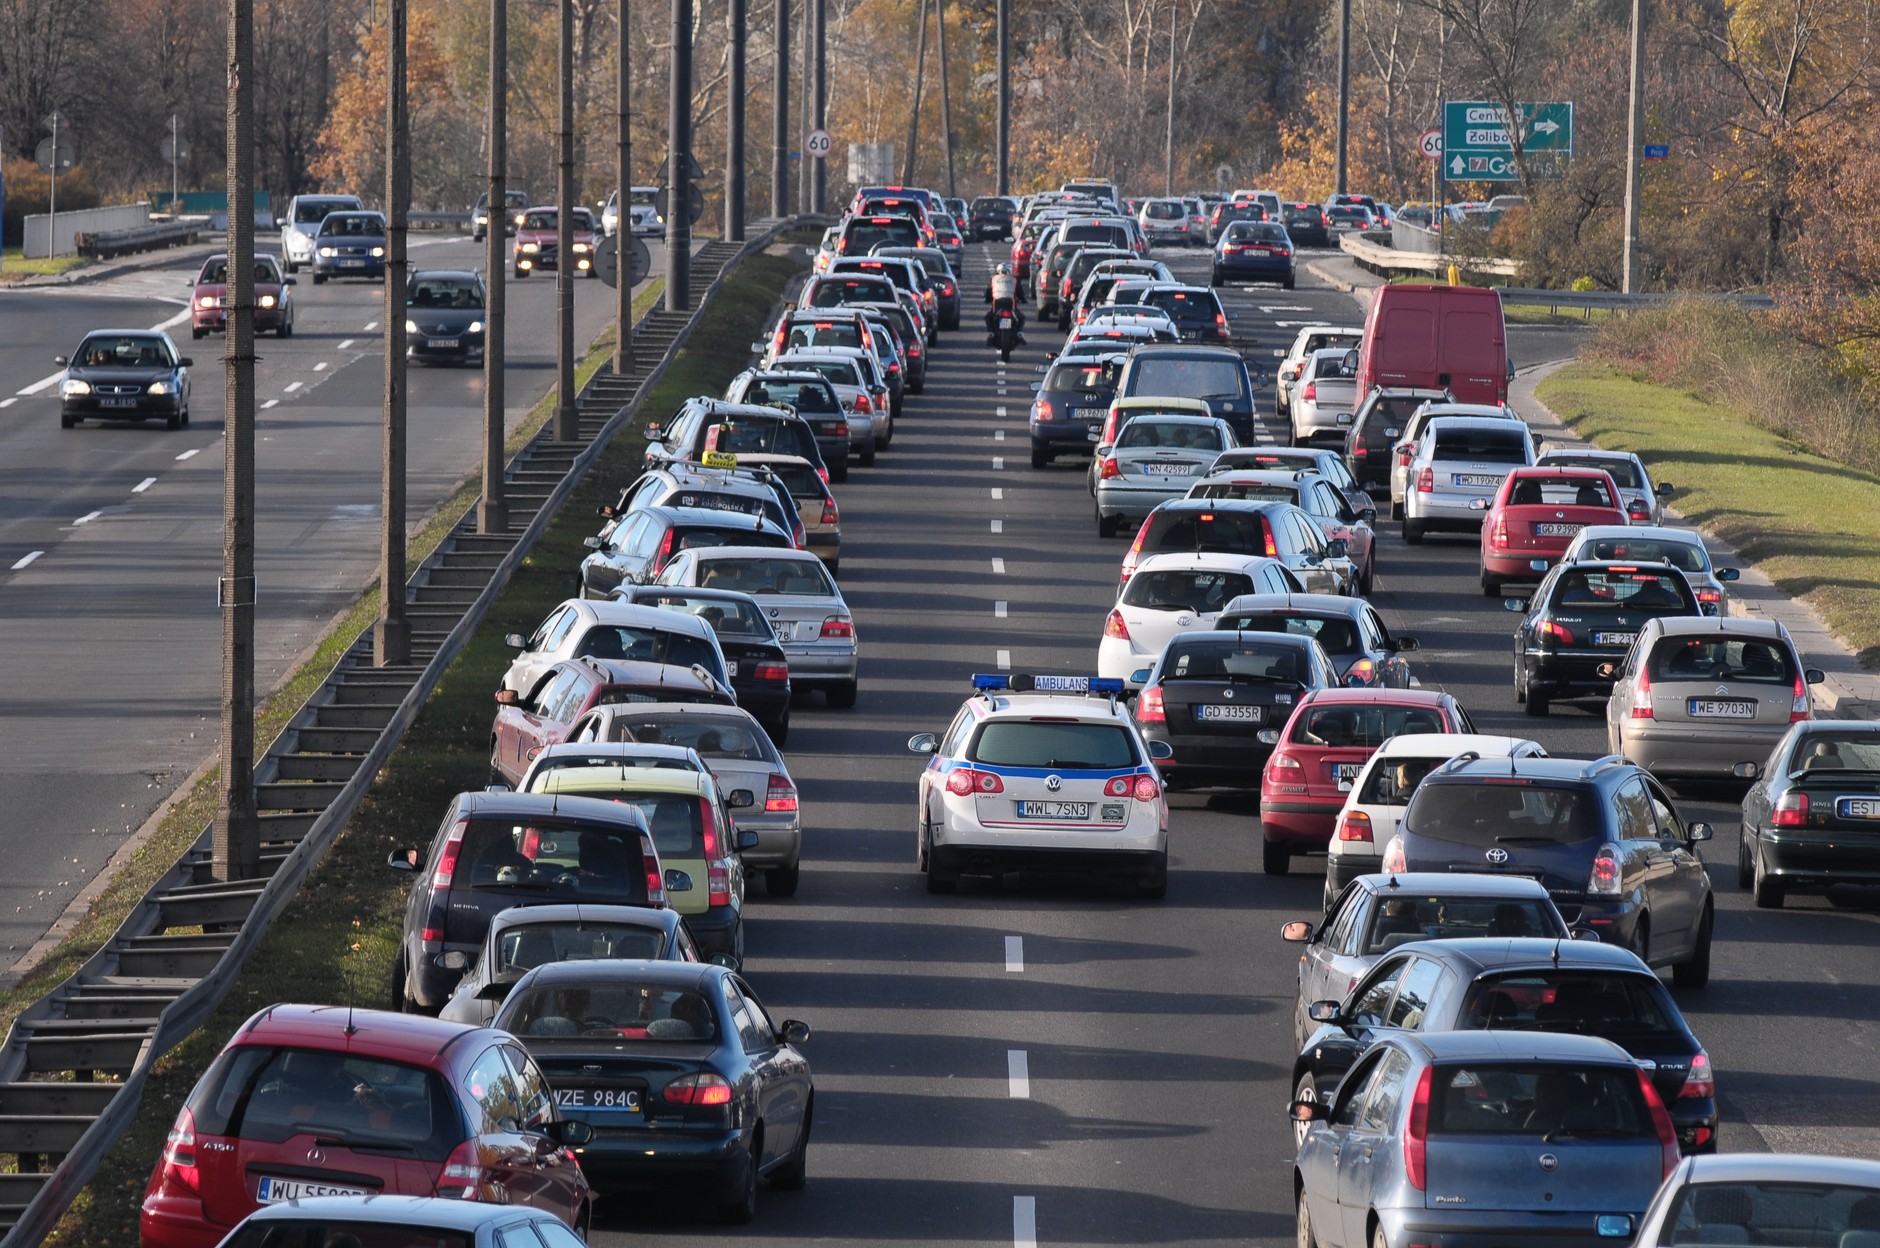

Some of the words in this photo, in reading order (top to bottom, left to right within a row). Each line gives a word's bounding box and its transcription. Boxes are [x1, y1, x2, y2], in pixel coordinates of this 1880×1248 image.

[1469, 109, 1524, 120] Centrm
[809, 136, 829, 150] 60
[1424, 136, 1442, 151] 60
[1474, 159, 1483, 171] 7
[1149, 464, 1162, 474] WN
[1163, 464, 1188, 475] 42599
[1542, 524, 1555, 534] GD
[1601, 633, 1616, 644] WE
[1035, 677, 1088, 690] AMBULANS
[1204, 706, 1221, 717] GD
[1224, 706, 1260, 718] 3355R
[1698, 702, 1714, 713] WE
[1718, 702, 1753, 715] 9703N
[1026, 802, 1052, 815] WWL
[1056, 803, 1087, 816] 7SN3
[593, 1090, 638, 1107] 984C
[271, 1181, 299, 1200] WU
[1435, 1195, 1467, 1203] Punto
